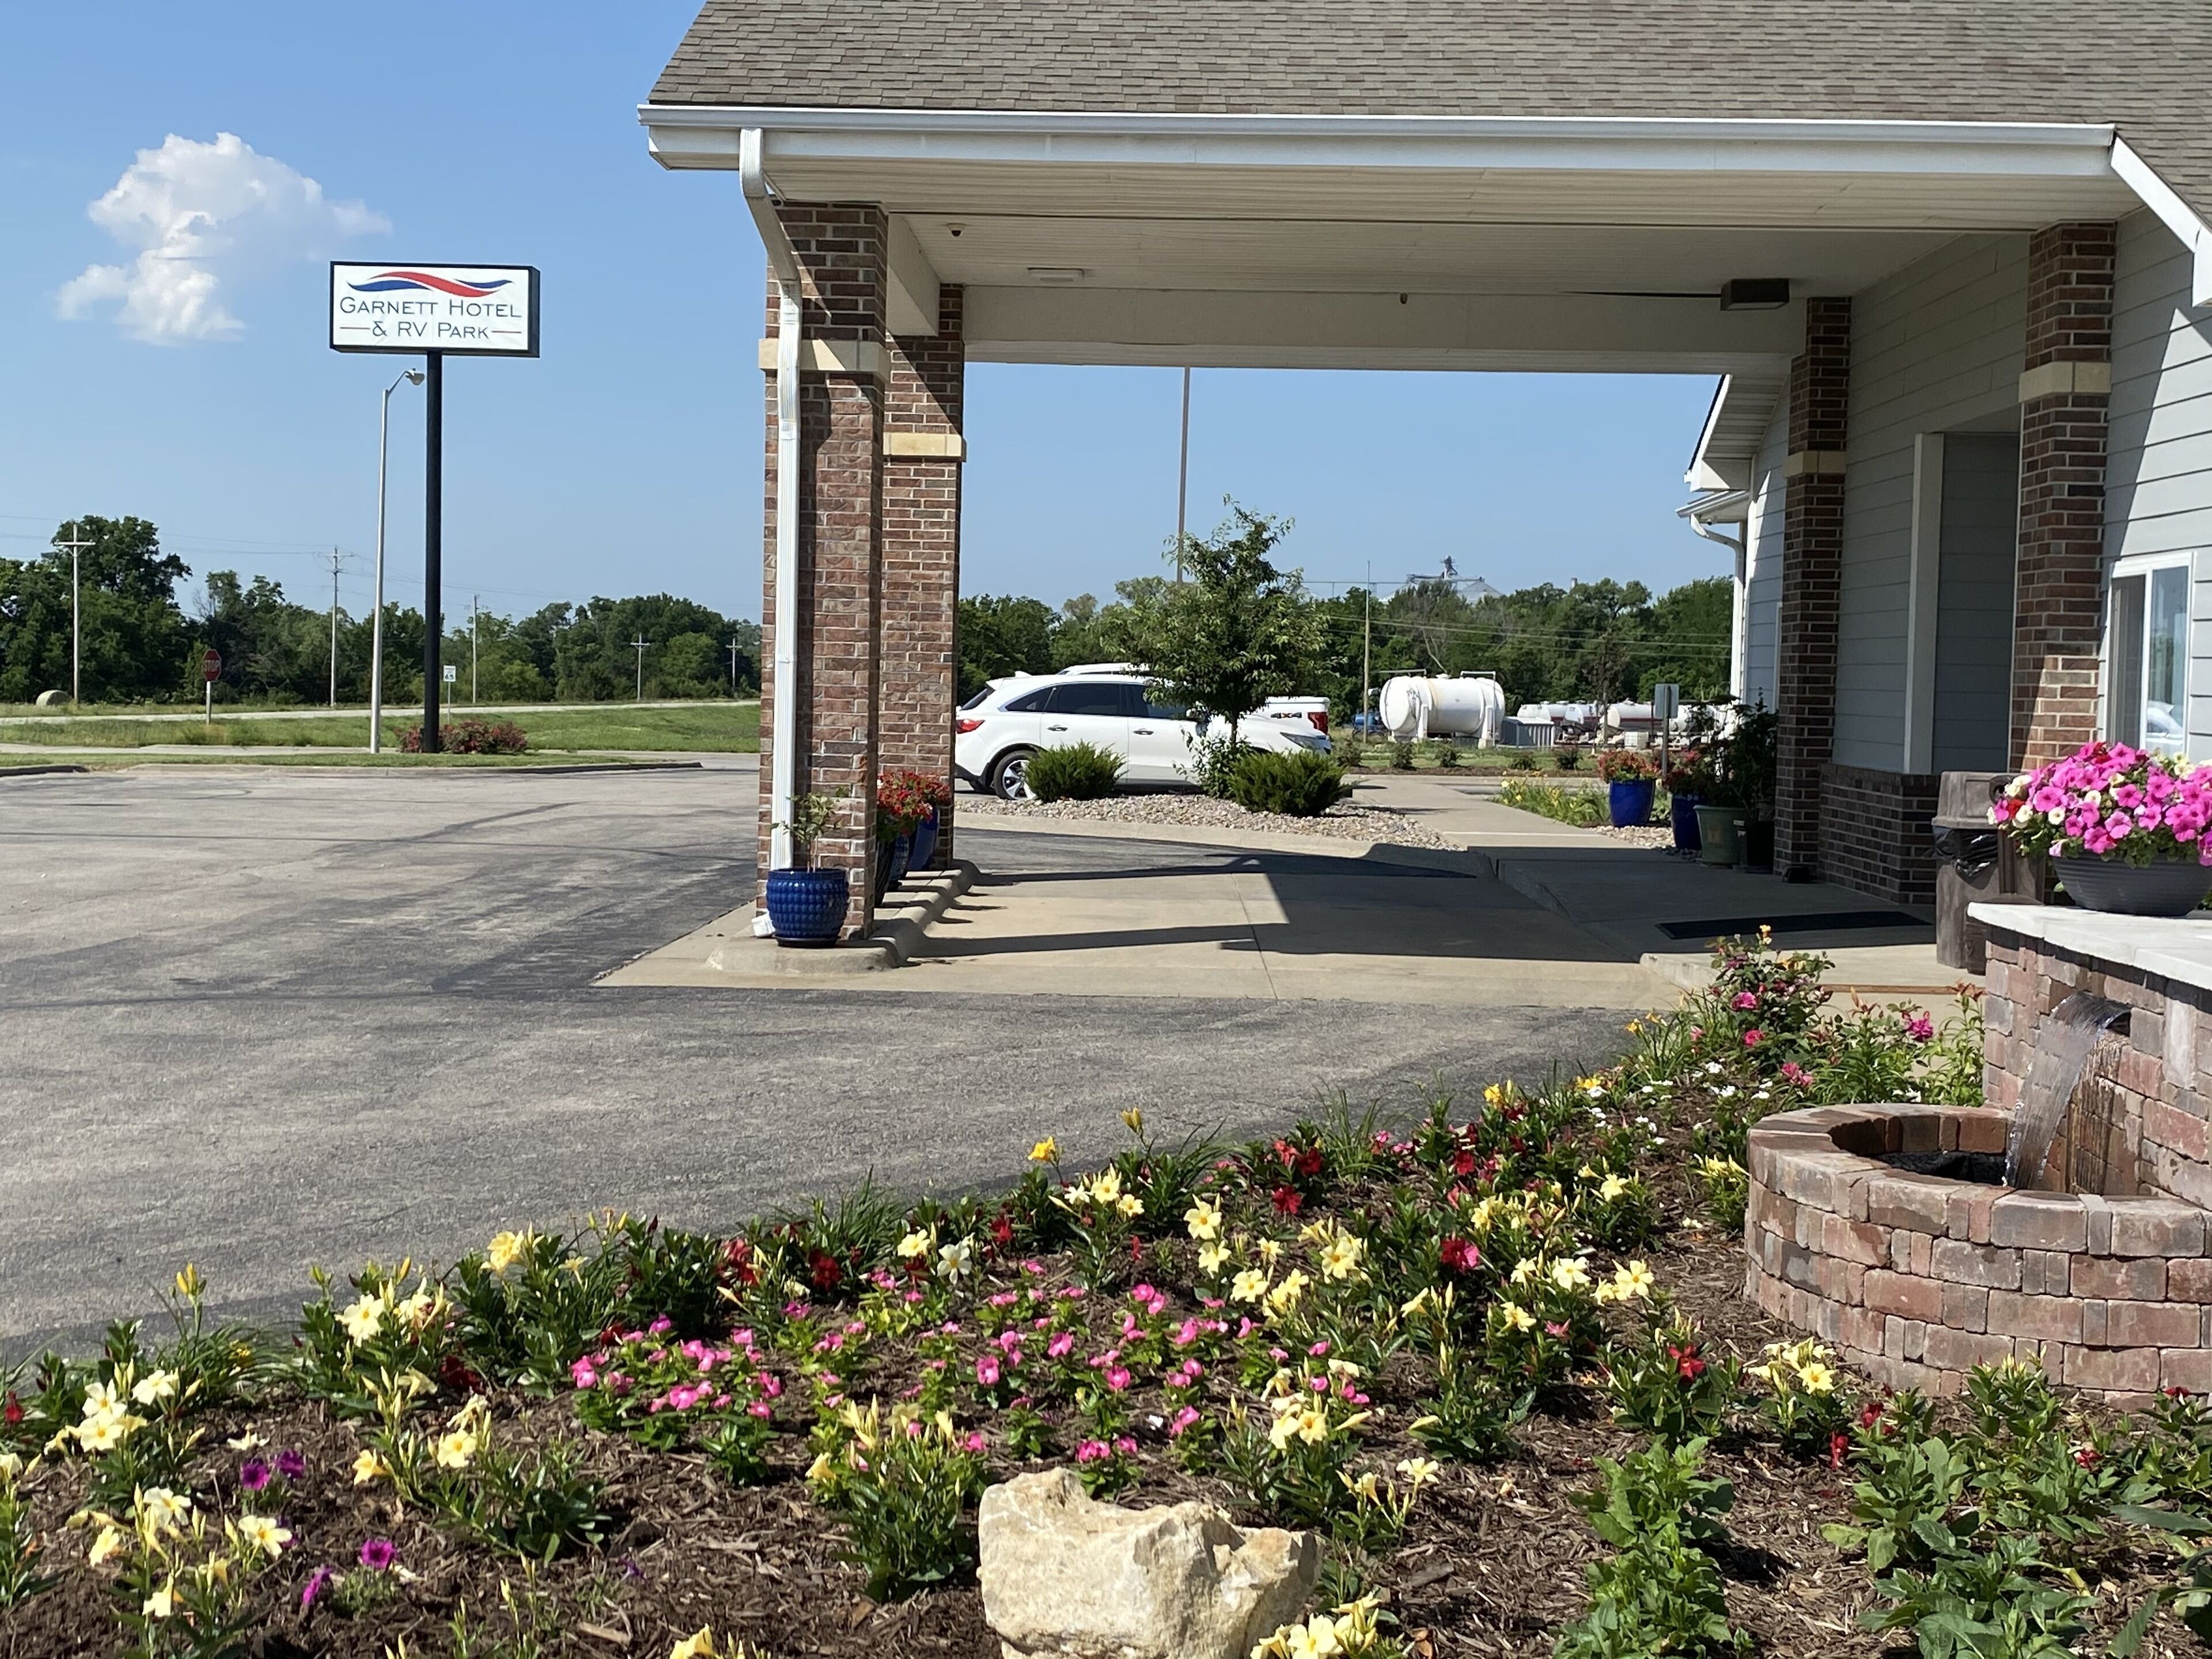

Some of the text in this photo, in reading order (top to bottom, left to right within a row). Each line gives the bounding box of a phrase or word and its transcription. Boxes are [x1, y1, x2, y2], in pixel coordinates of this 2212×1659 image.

[339, 296, 522, 318] GARNETT HOTEL
[372, 320, 490, 339] & RV PARK
[202, 659, 219, 673] STOP
